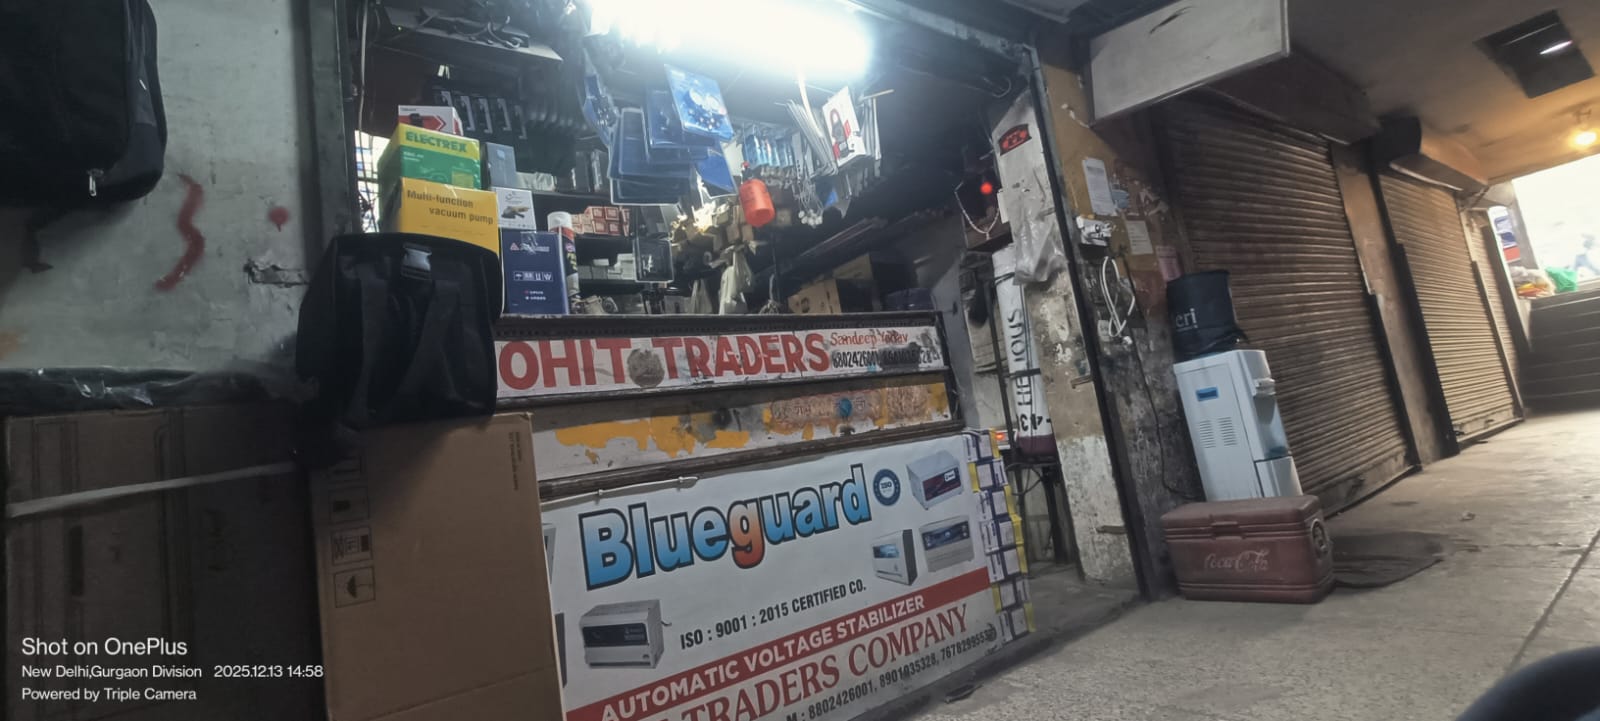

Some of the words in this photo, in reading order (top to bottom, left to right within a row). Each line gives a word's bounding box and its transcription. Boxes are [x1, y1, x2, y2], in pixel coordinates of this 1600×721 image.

[405, 130, 467, 153] ELECTREX
[406, 189, 475, 209] Multi-function
[428, 206, 468, 220] vacuum
[469, 210, 494, 225] pump
[652, 333, 831, 380] TRADERS
[830, 331, 878, 349] Sandeep
[1006, 308, 1033, 407] HEIOUS
[578, 463, 873, 591] Blueguard
[679, 628, 704, 650] ISO
[715, 614, 748, 639] 9001
[759, 602, 790, 627] 2015
[791, 586, 846, 616] CERTIFIED
[848, 579, 867, 600] CO.
[600, 659, 740, 721] AUTOMATIC
[744, 624, 835, 672] VOLTAGE
[836, 594, 926, 640] STABILIZER
[848, 603, 969, 675] COMPANY
[808, 680, 878, 719] 8802426001,
